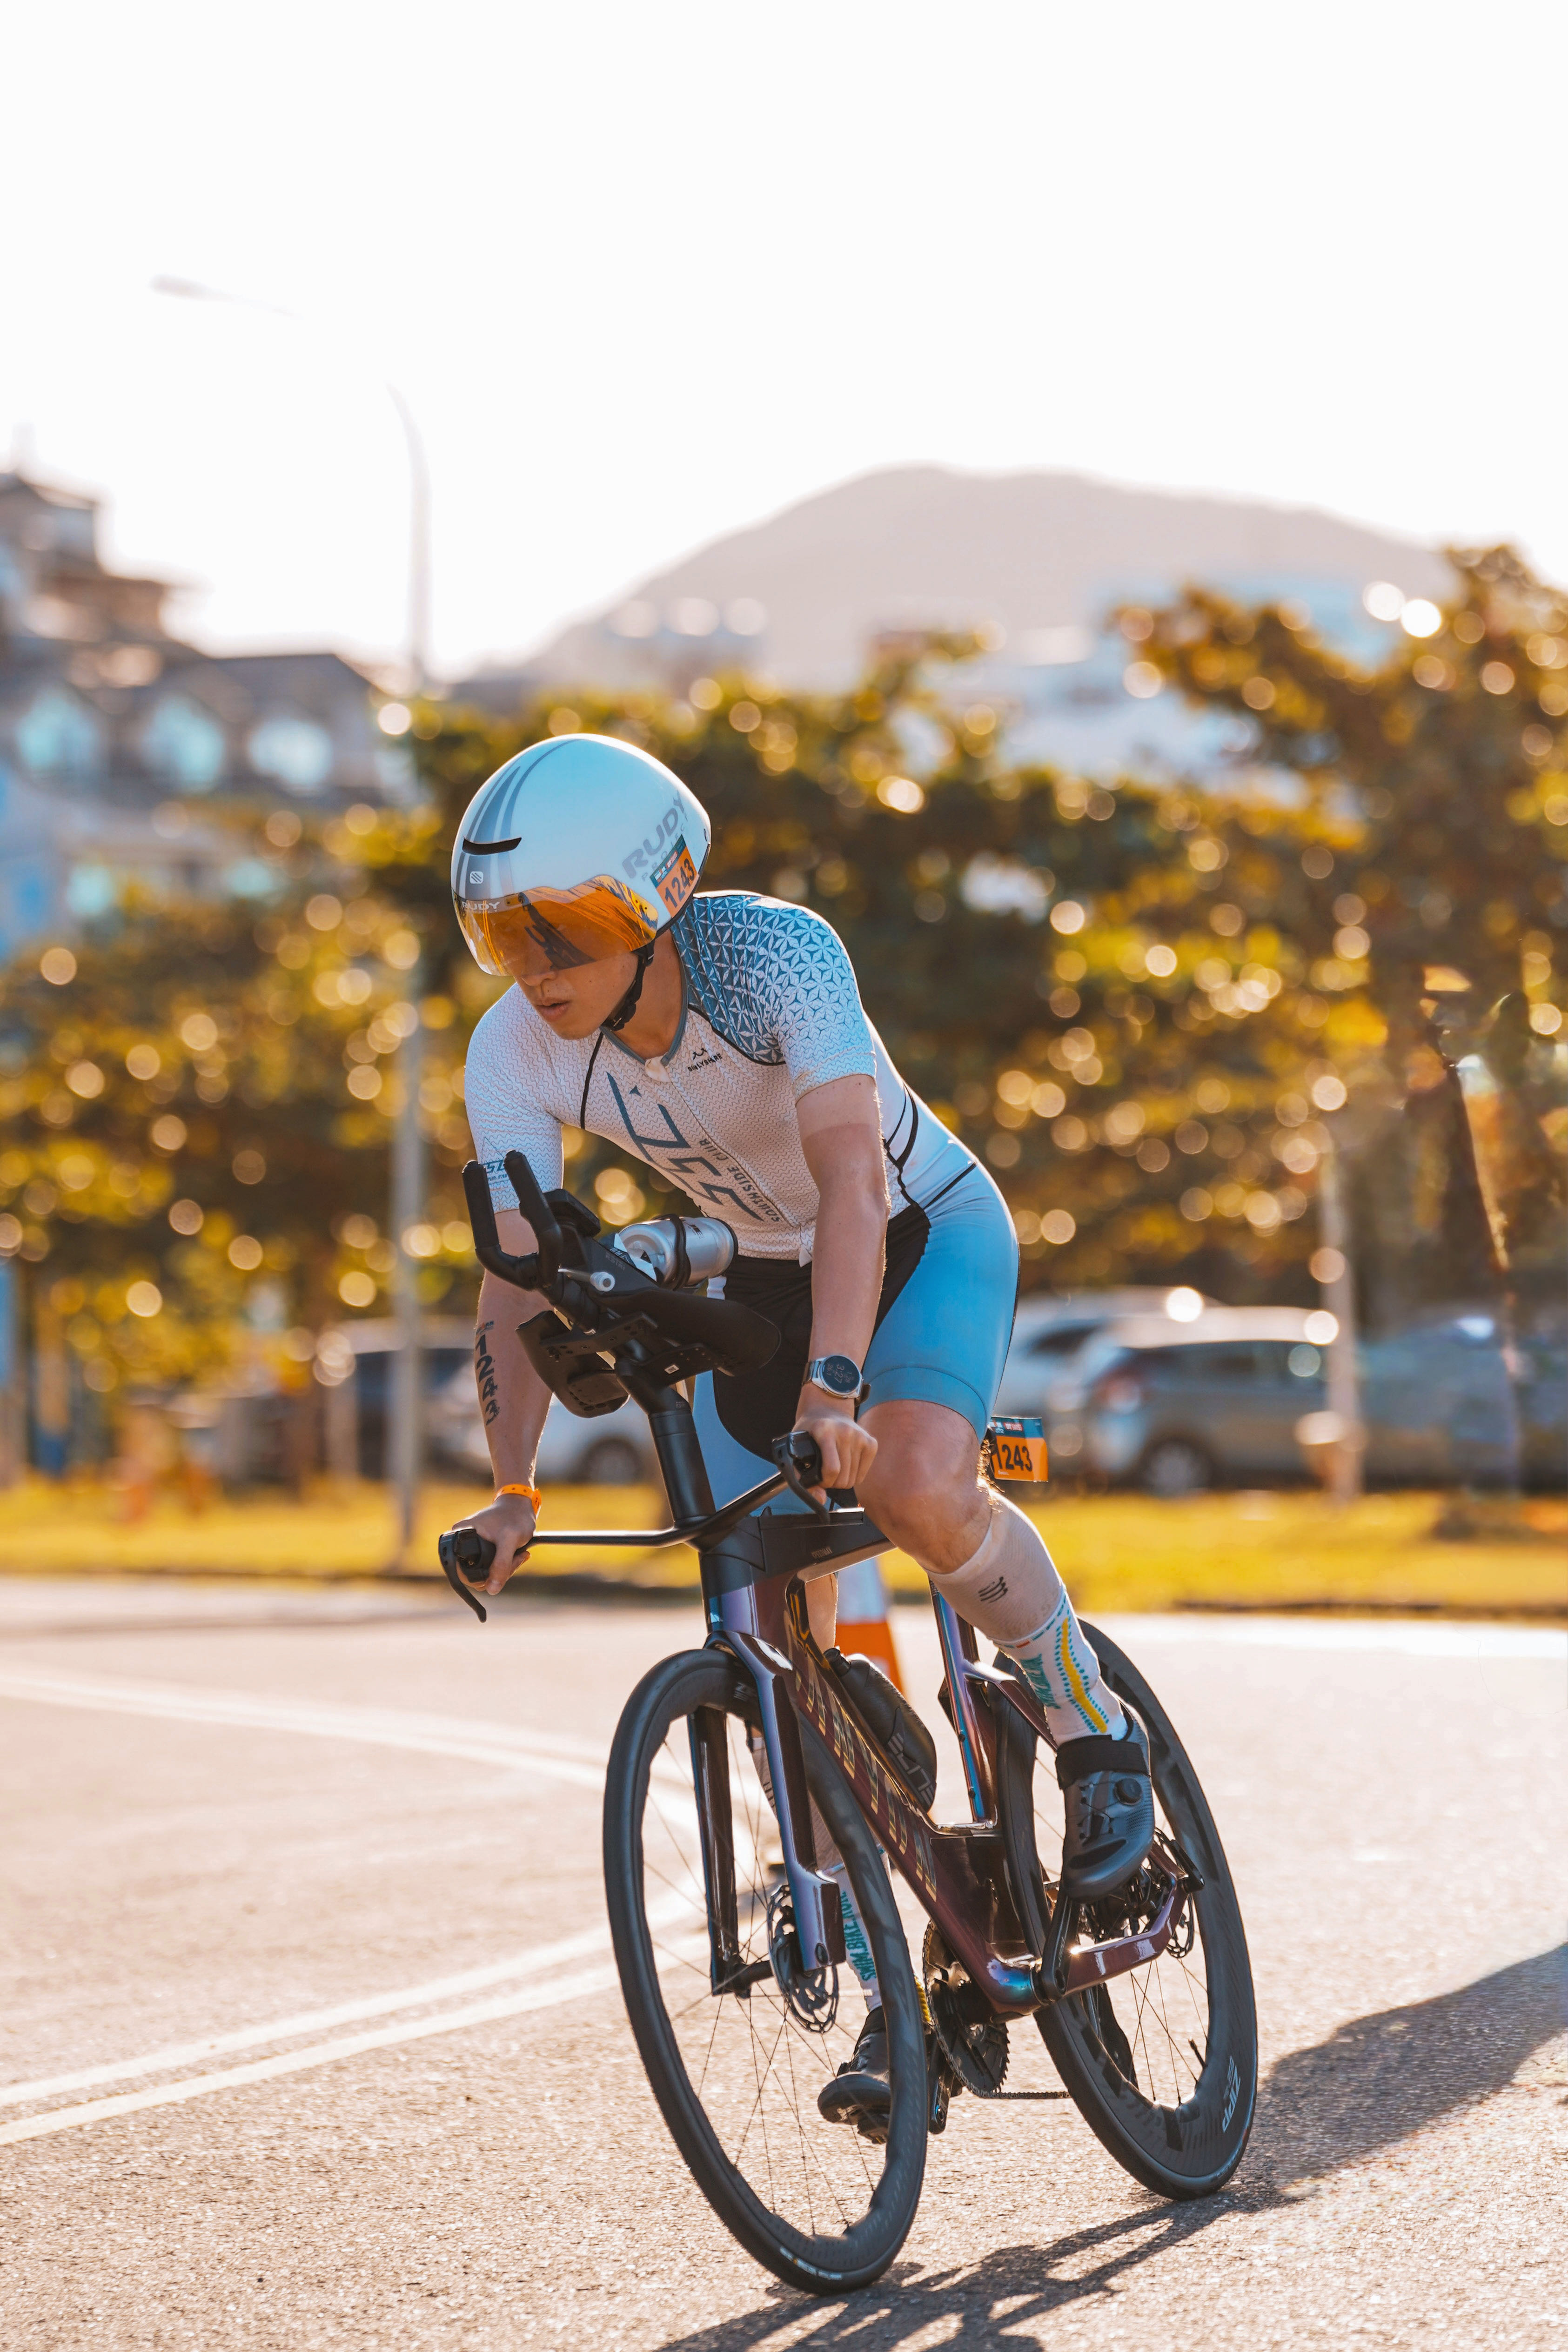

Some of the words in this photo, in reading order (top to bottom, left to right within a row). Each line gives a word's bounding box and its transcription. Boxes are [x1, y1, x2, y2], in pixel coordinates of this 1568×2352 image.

[622, 790, 685, 879] RUDY
[665, 858, 696, 908] 1243
[699, 1138, 729, 1161] CLUB
[727, 1166, 781, 1222] SOUTHSIDE
[475, 1334, 501, 1427] 1243
[991, 1444, 1033, 1472] 1243
